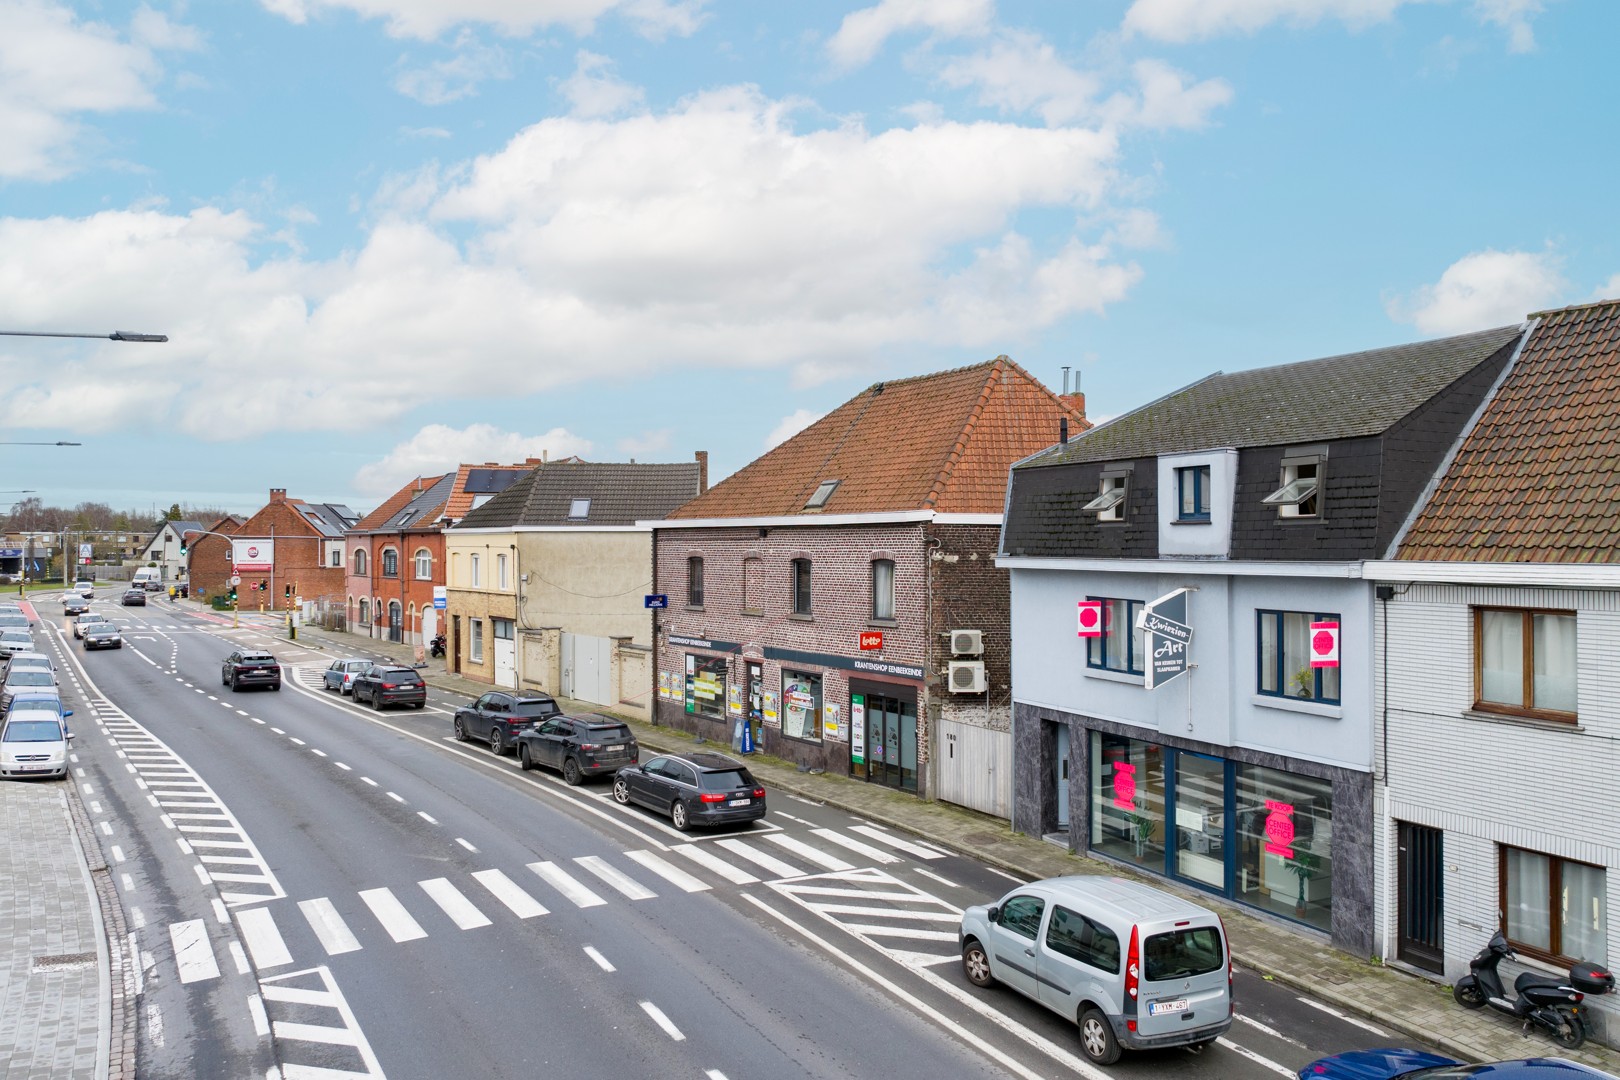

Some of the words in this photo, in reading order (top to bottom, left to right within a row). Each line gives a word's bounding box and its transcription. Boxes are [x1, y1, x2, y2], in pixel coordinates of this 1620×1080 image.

[1154, 640, 1184, 658] Art
[854, 660, 888, 672] KRANTENSHOP
[1274, 803, 1291, 813] KOOP
[1268, 819, 1291, 832] CENTER
[1268, 827, 1292, 840] OFFICE
